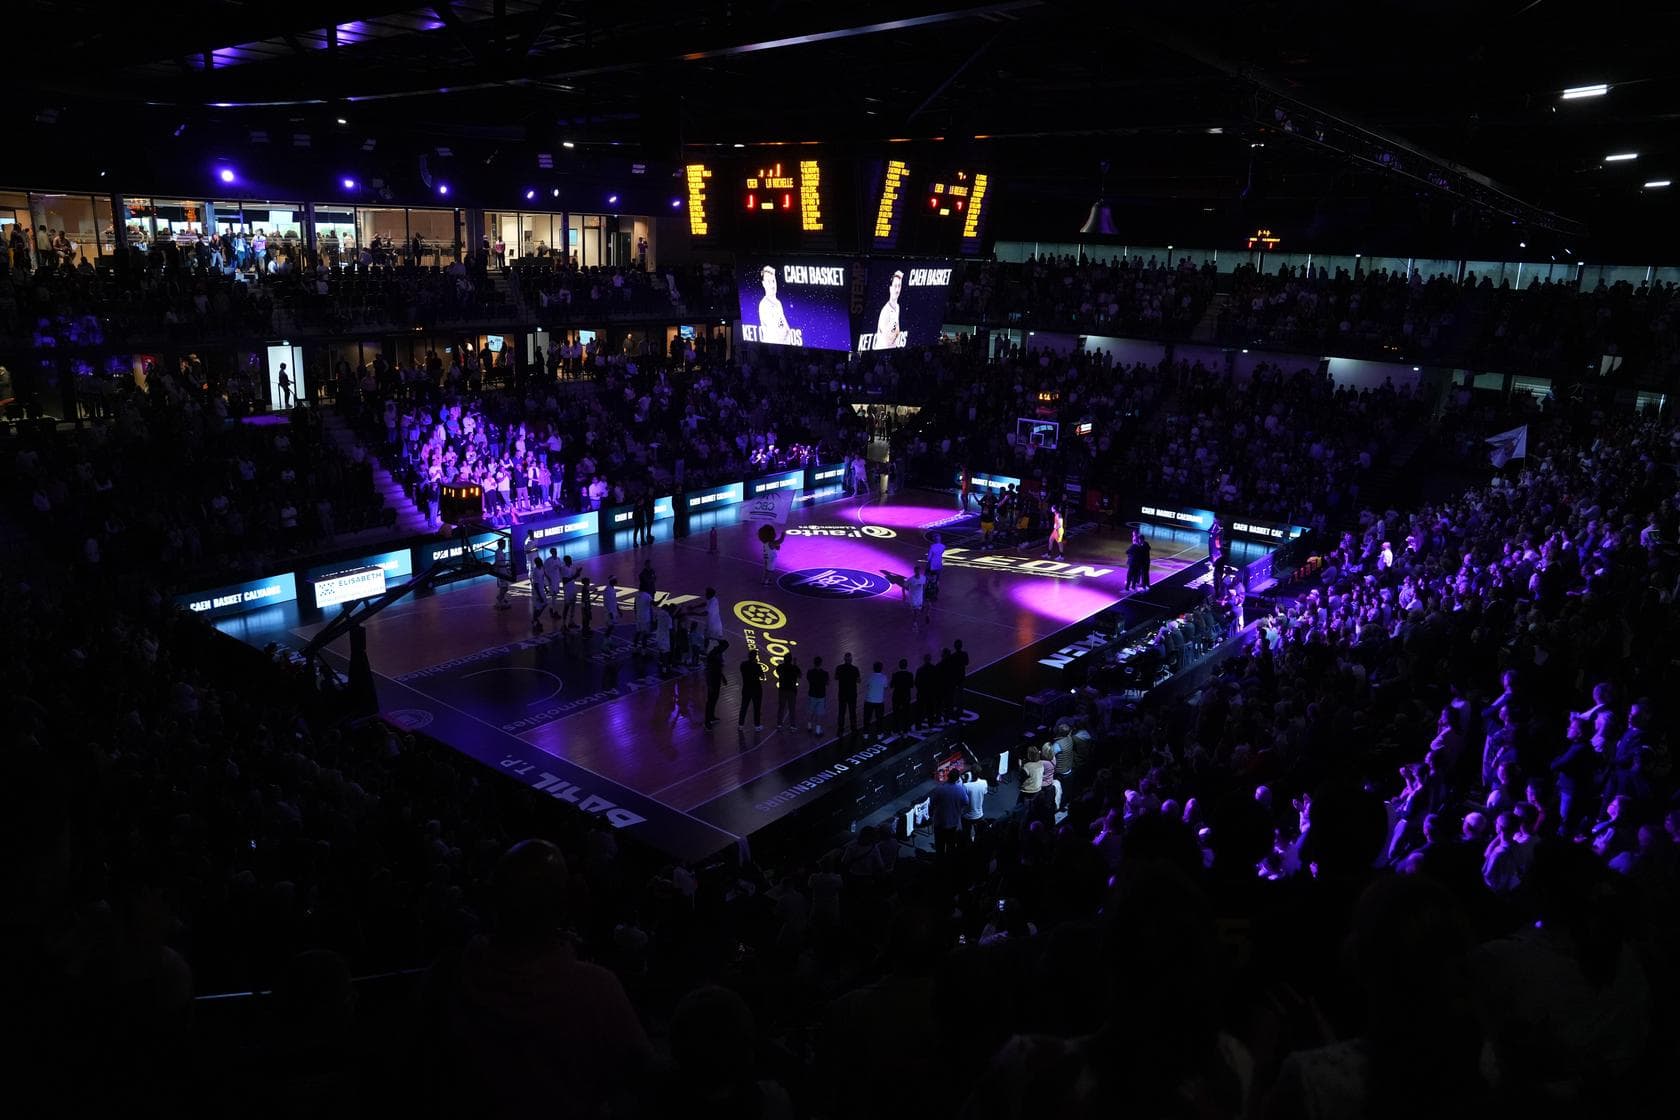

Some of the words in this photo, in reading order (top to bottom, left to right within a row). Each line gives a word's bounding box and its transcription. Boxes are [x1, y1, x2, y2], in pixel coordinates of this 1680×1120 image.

[783, 265, 808, 284] CAEN
[810, 267, 845, 287] BASKET
[908, 268, 926, 286] CAEN
[925, 268, 952, 286] BASKET
[337, 572, 382, 587] ELISABETH
[213, 592, 242, 609] BASKET
[501, 687, 619, 732] Automobiles
[845, 743, 888, 767] ECOLE
[754, 762, 851, 813] D'INGENIEURS
